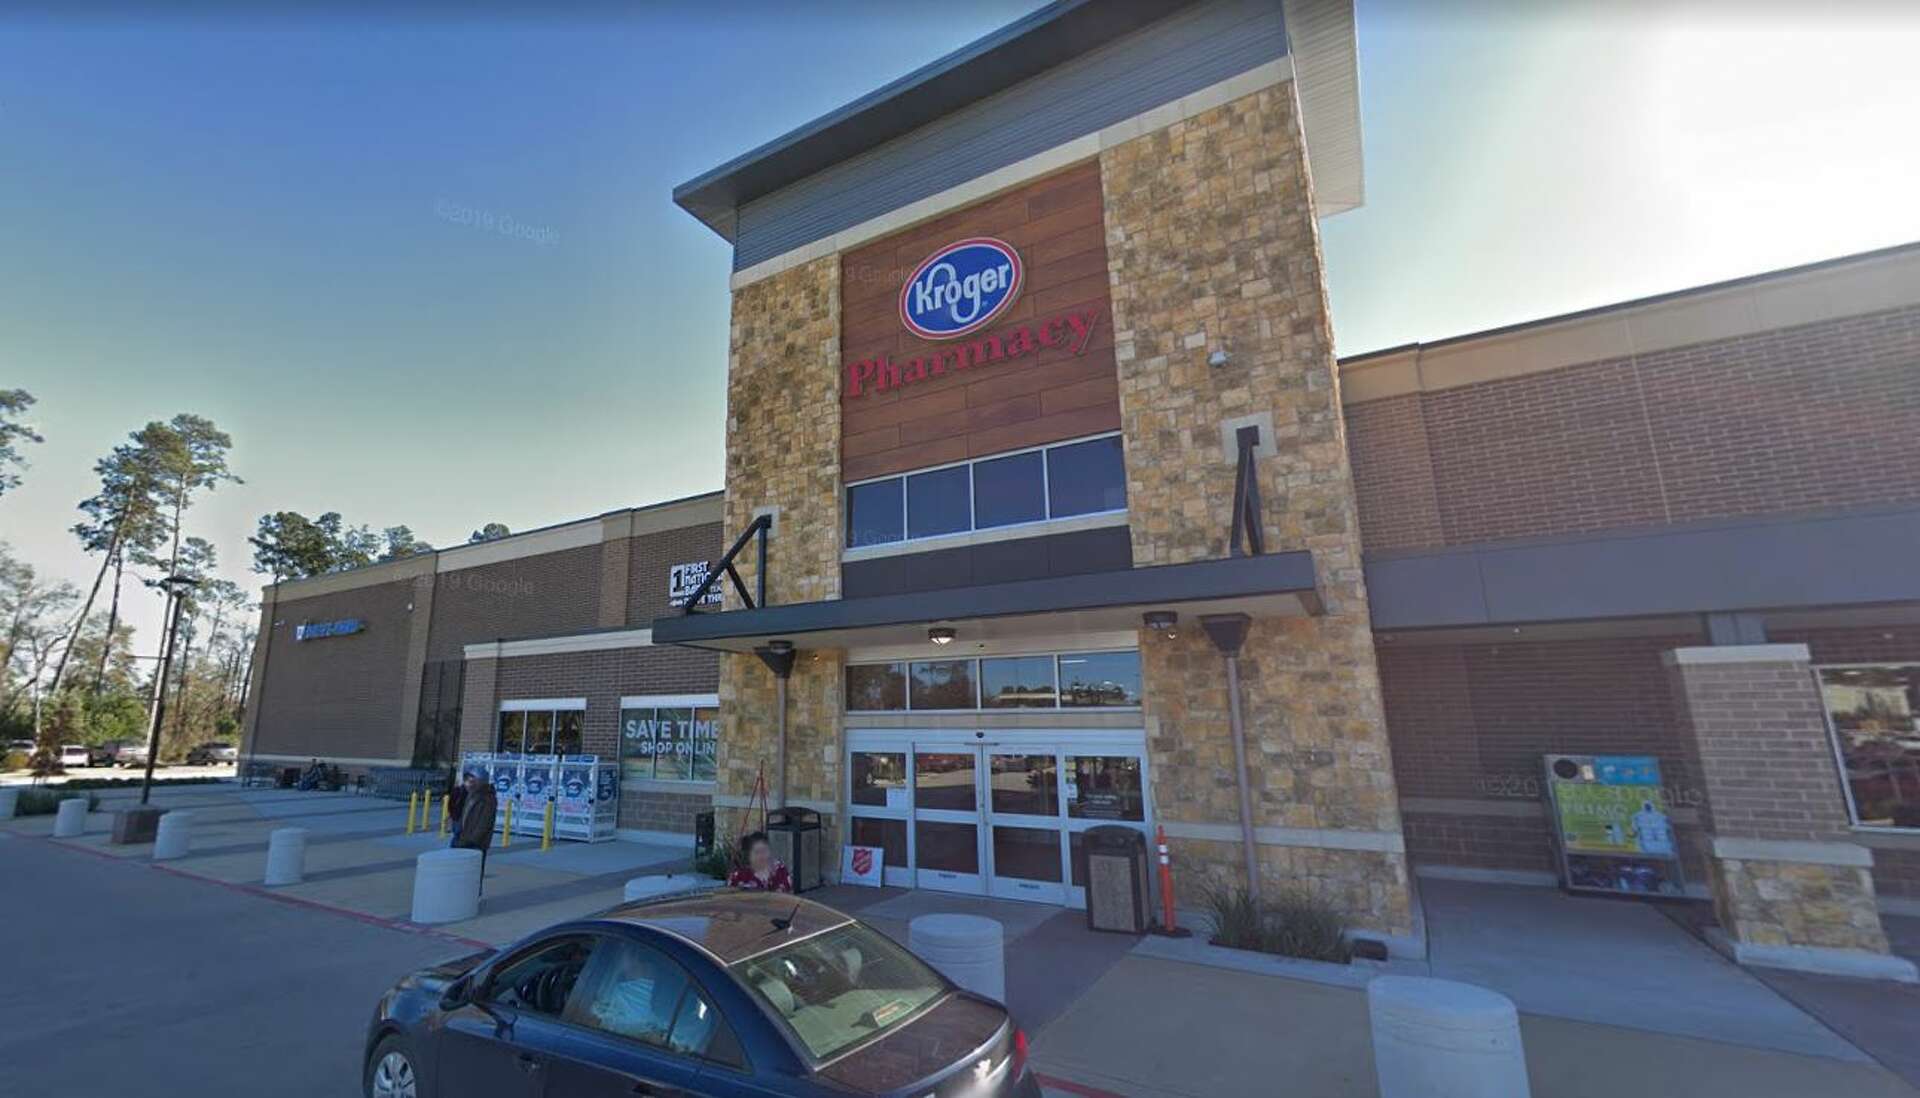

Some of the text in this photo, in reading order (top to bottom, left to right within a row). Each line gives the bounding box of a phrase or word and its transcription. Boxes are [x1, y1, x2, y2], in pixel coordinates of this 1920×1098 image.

[915, 262, 1010, 324] Kroger
[847, 309, 1097, 398] Pharmacy
[685, 561, 708, 574] FIRST
[626, 719, 672, 738] SAVE
[640, 741, 715, 754] SHOP ONLIN
